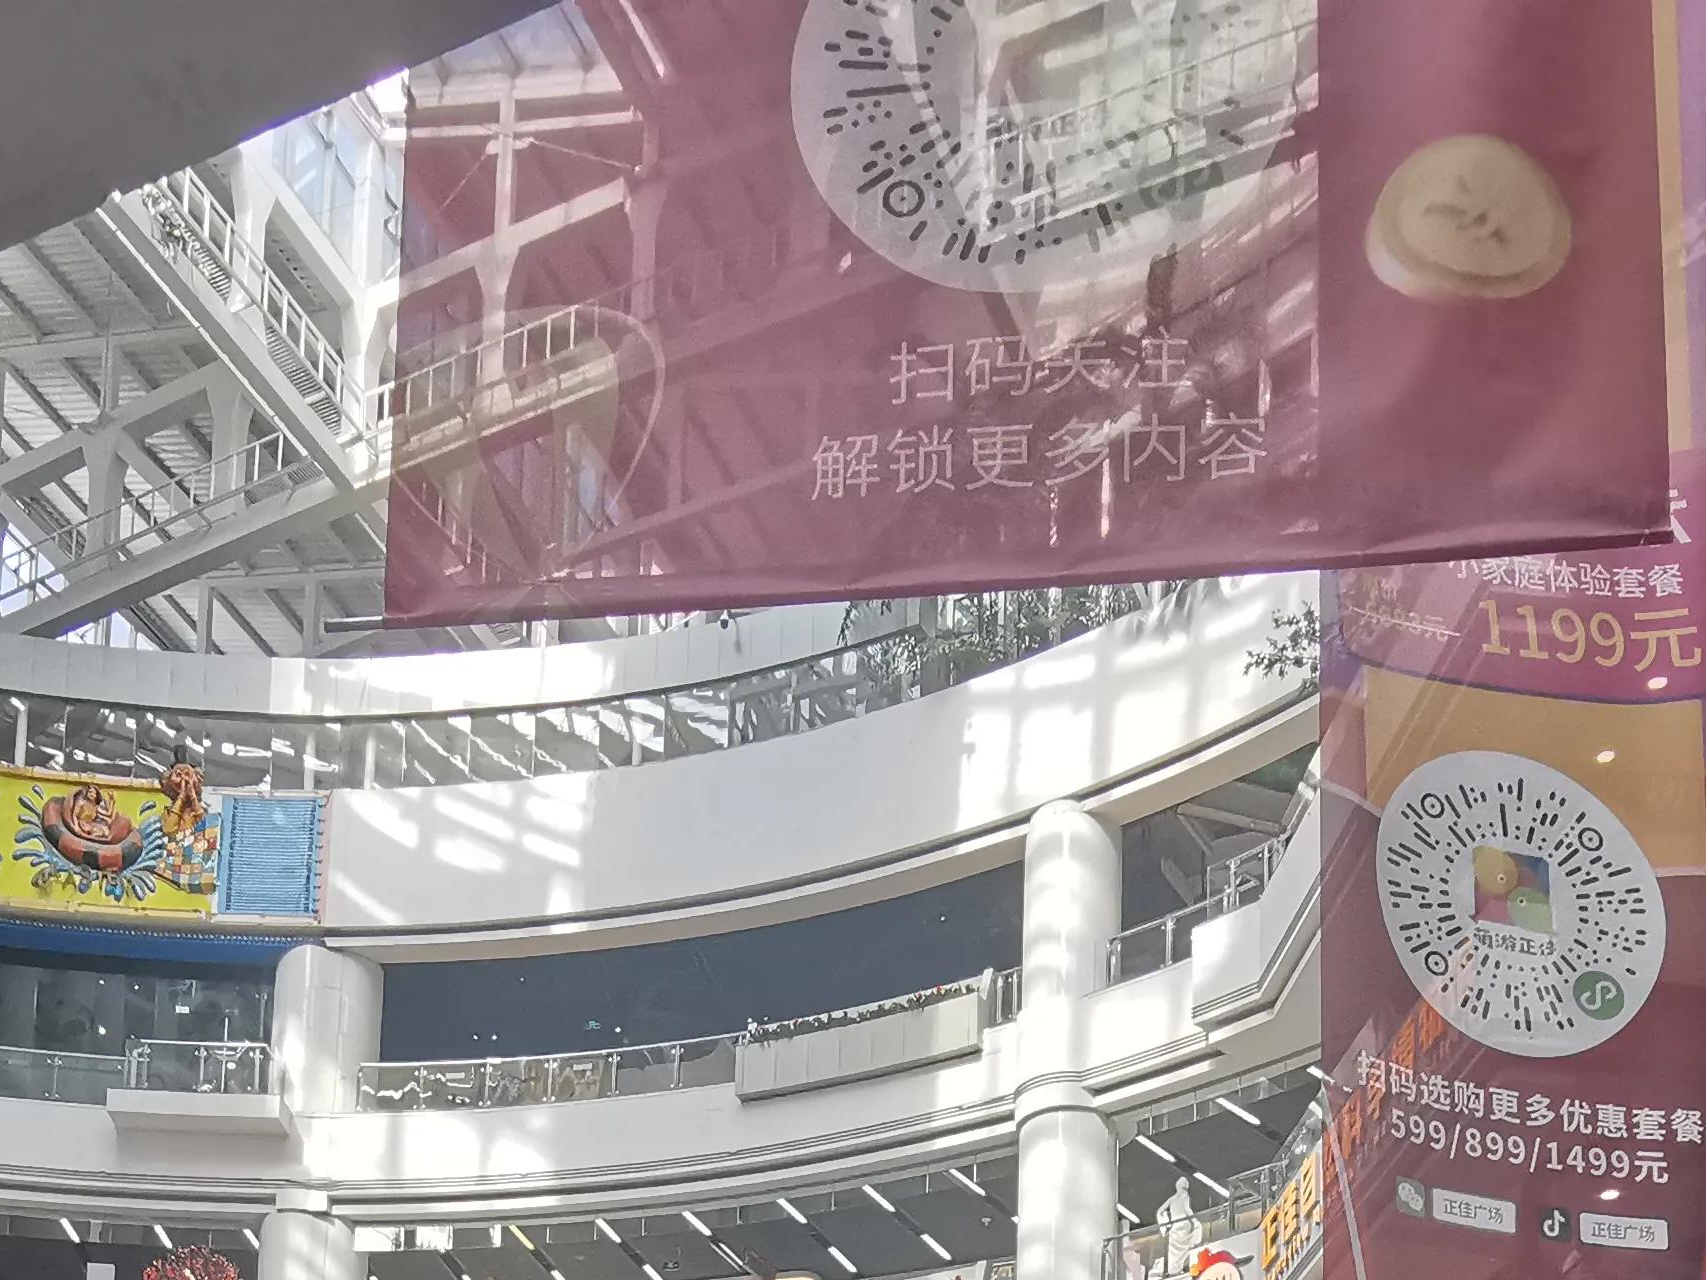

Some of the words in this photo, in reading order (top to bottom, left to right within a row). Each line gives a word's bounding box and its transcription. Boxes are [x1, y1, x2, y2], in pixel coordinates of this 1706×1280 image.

[889, 325, 1190, 405] 扫码关注
[811, 412, 1268, 500] 解锁更多内容
[1478, 599, 1702, 673] 1199元
[1356, 1050, 1705, 1145] 扫码选购更多优惠套餐
[1390, 1114, 1670, 1184] 599/899/1499元
[1443, 1198, 1505, 1225] 正佳广场
[1590, 1222, 1655, 1244] 正佳广场
